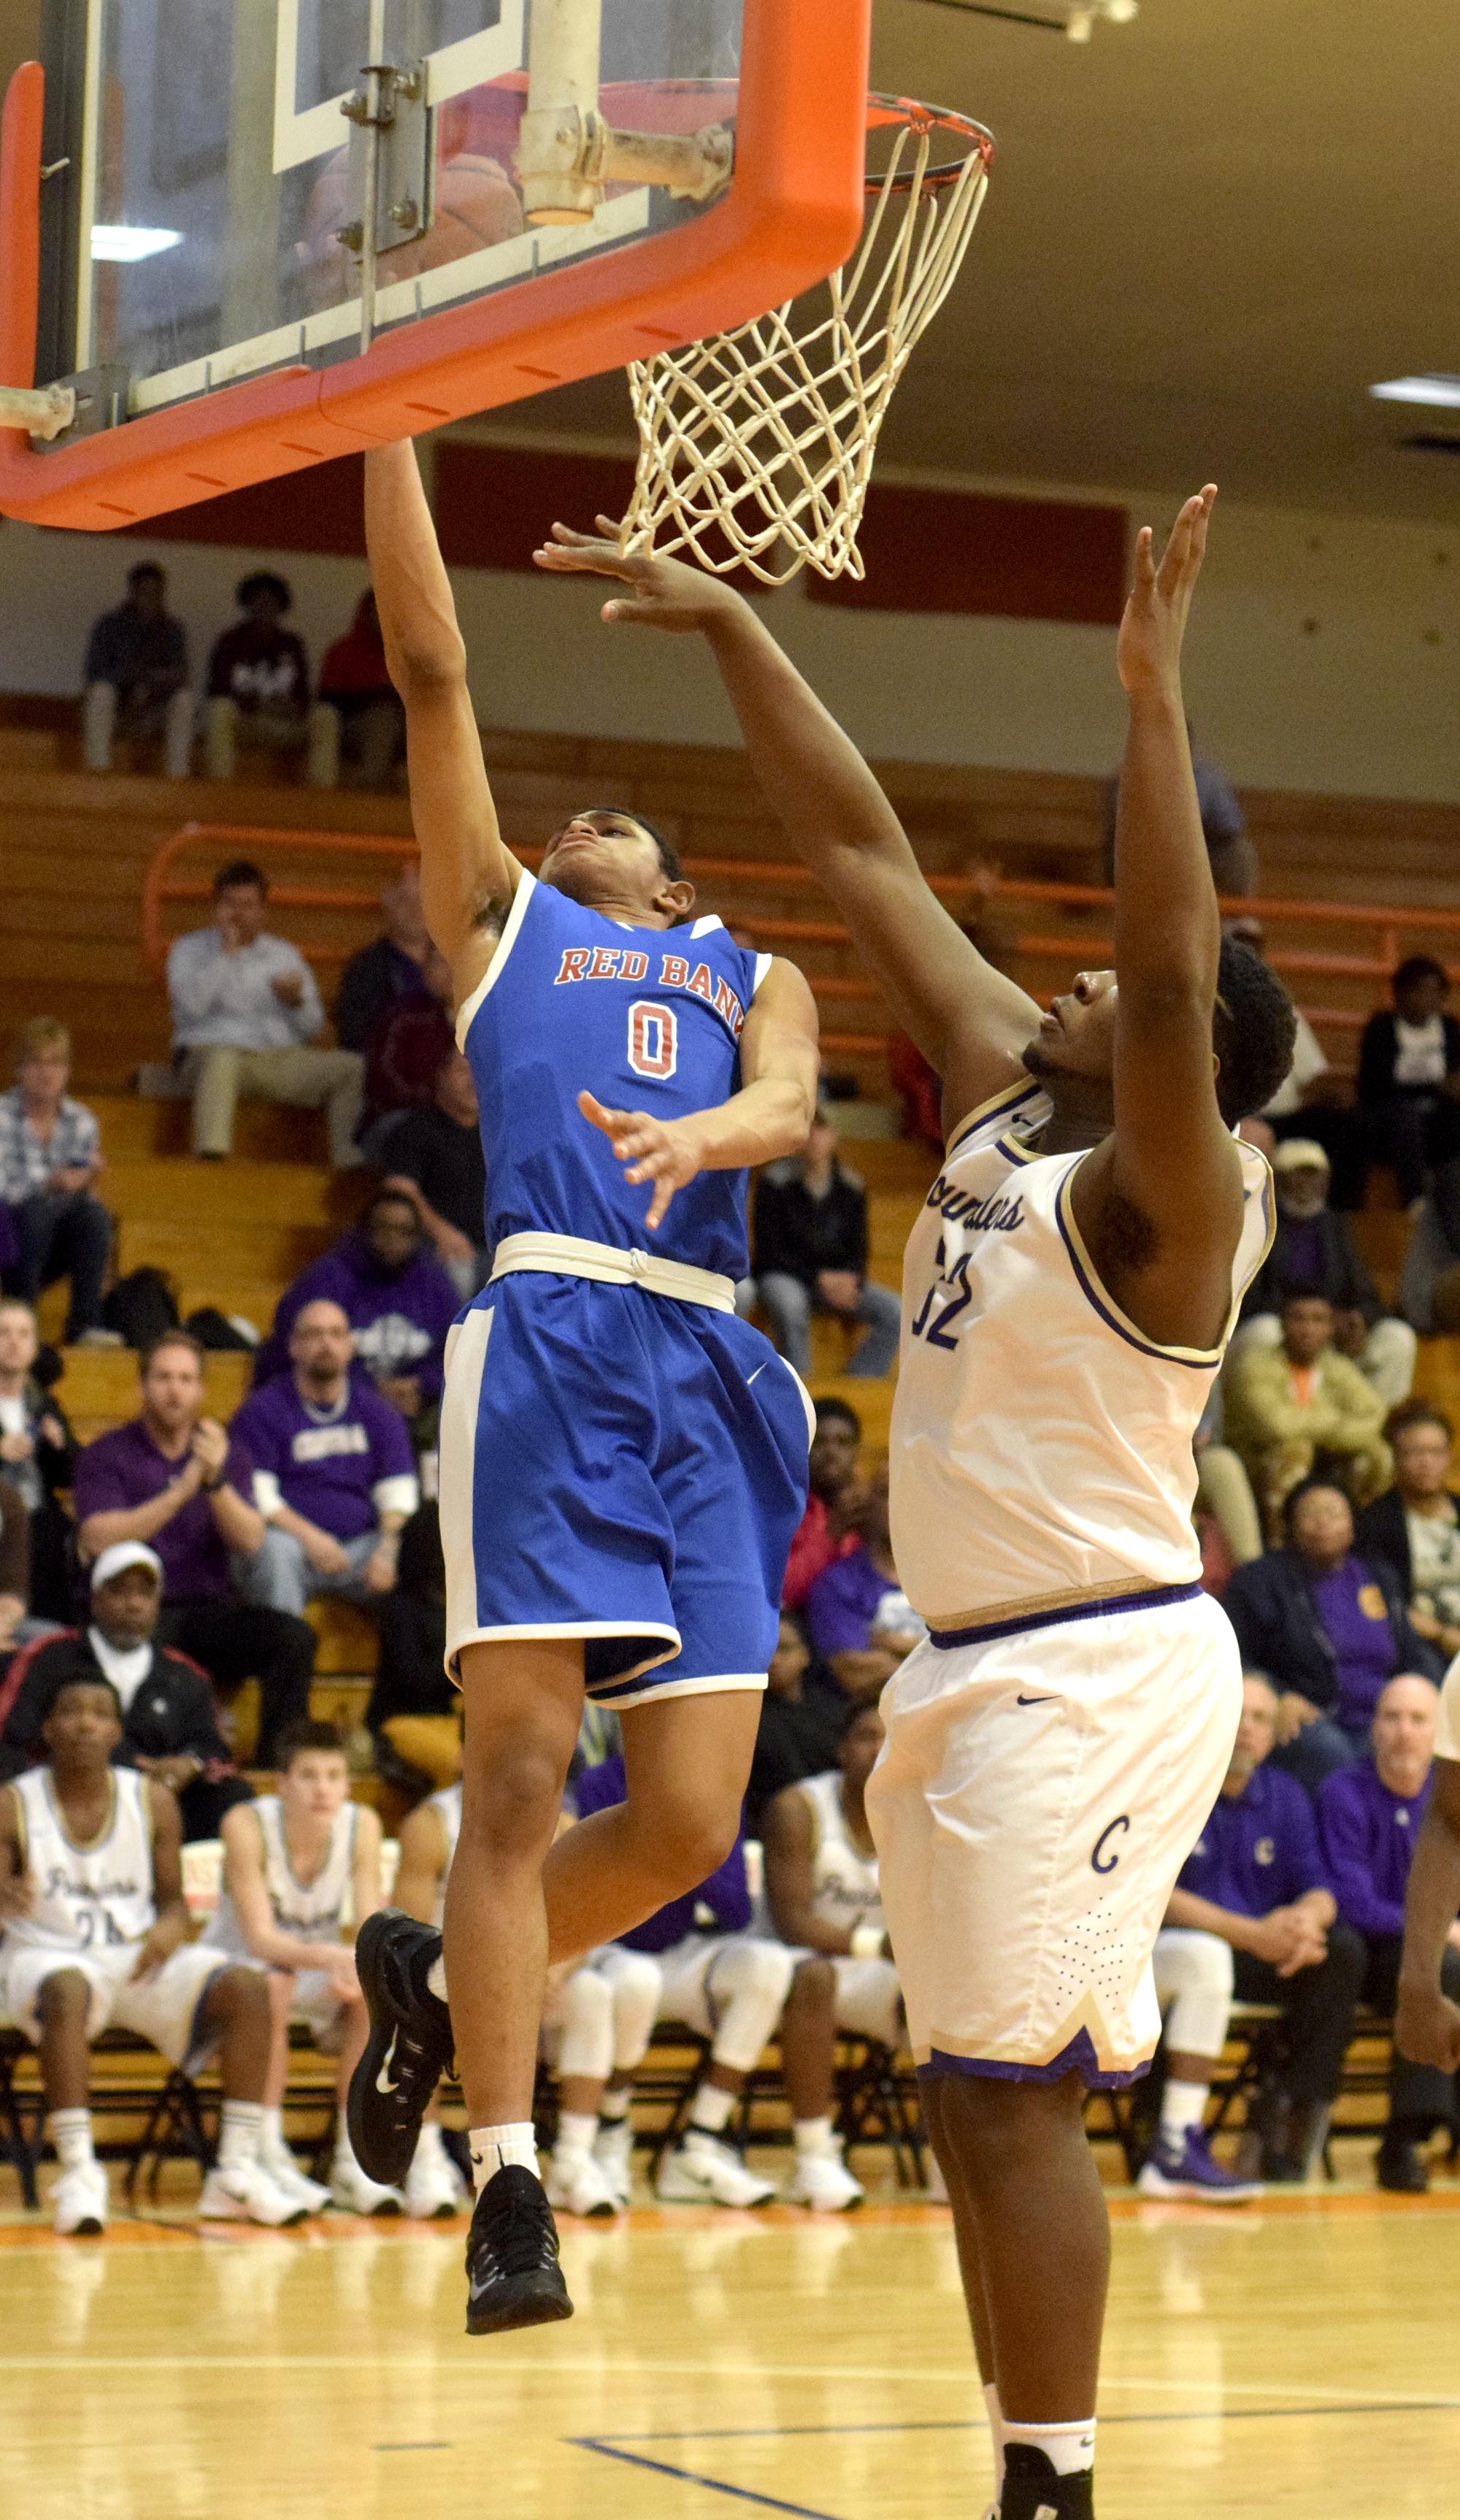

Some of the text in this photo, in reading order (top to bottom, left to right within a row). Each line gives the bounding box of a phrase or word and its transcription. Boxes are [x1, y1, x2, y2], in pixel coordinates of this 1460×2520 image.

[553, 946, 649, 985] RED
[627, 1000, 678, 1081] 0
[1091, 1815, 1130, 1874] C
